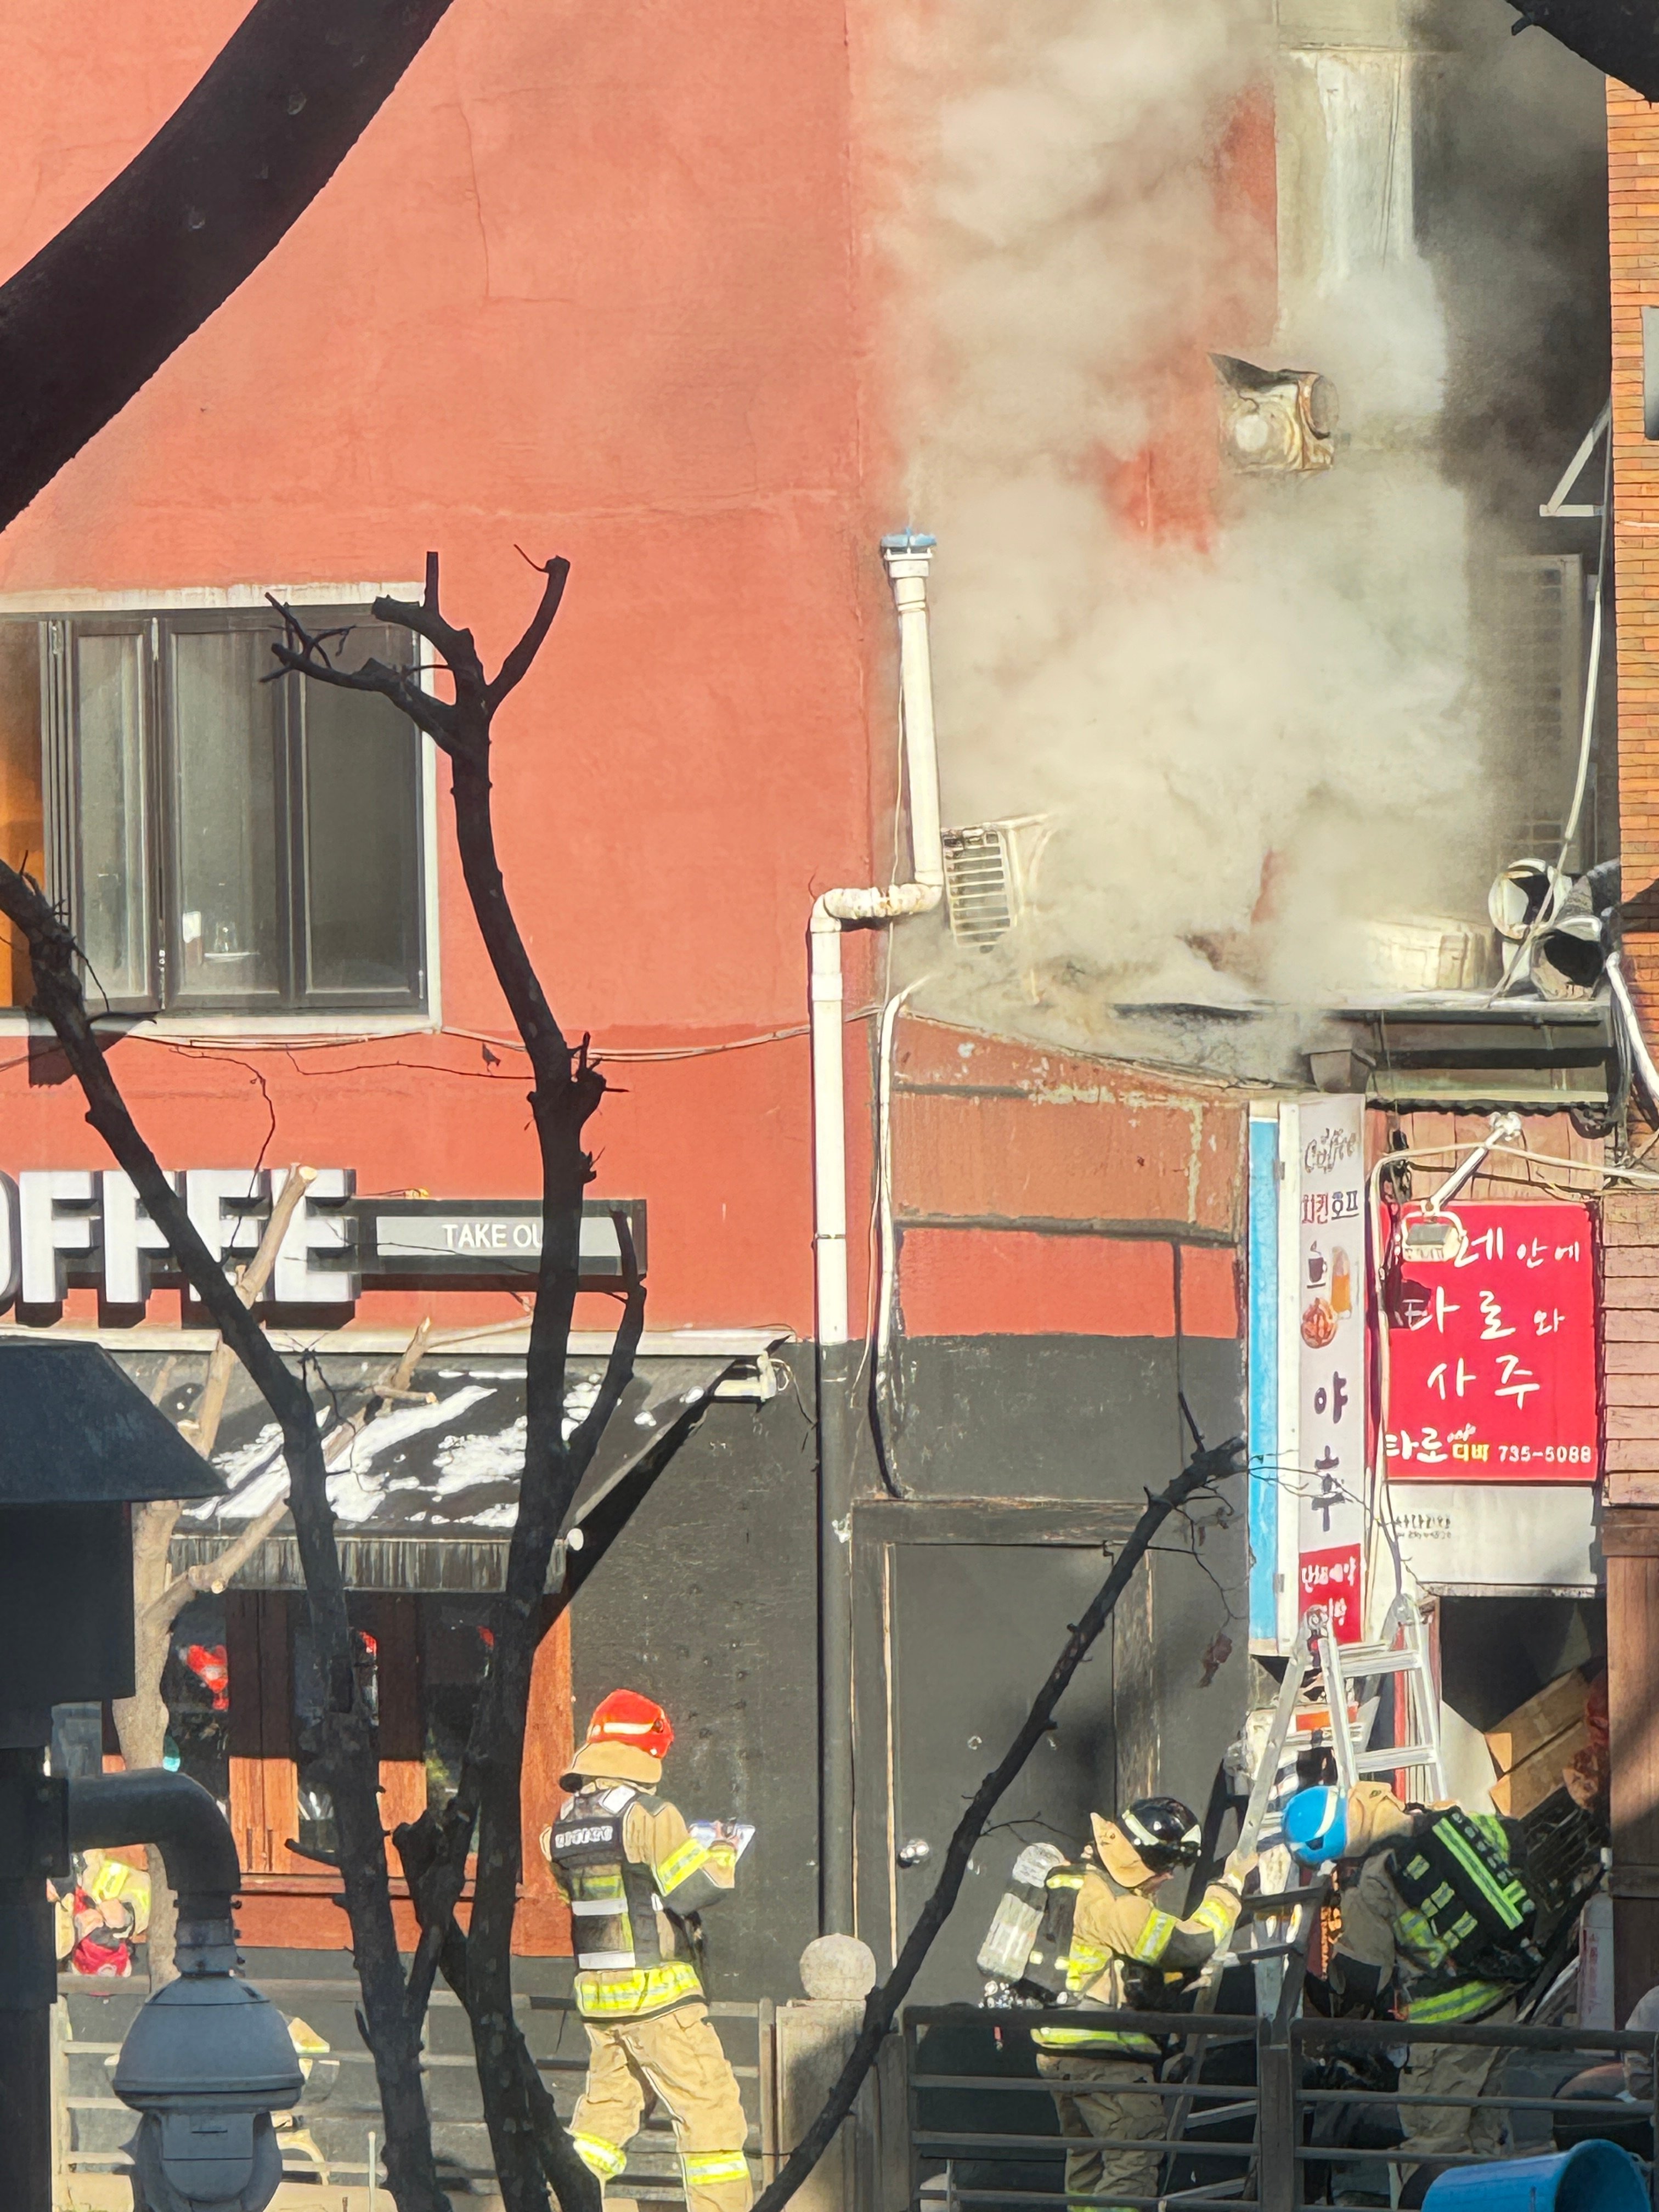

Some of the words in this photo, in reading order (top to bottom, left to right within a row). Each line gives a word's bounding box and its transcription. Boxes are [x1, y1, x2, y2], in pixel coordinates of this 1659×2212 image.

[0, 1169, 352, 1302] FFEE
[443, 1223, 507, 1248] TAKE
[514, 1224, 544, 1248] OU
[1427, 1355, 1541, 1410] 사주
